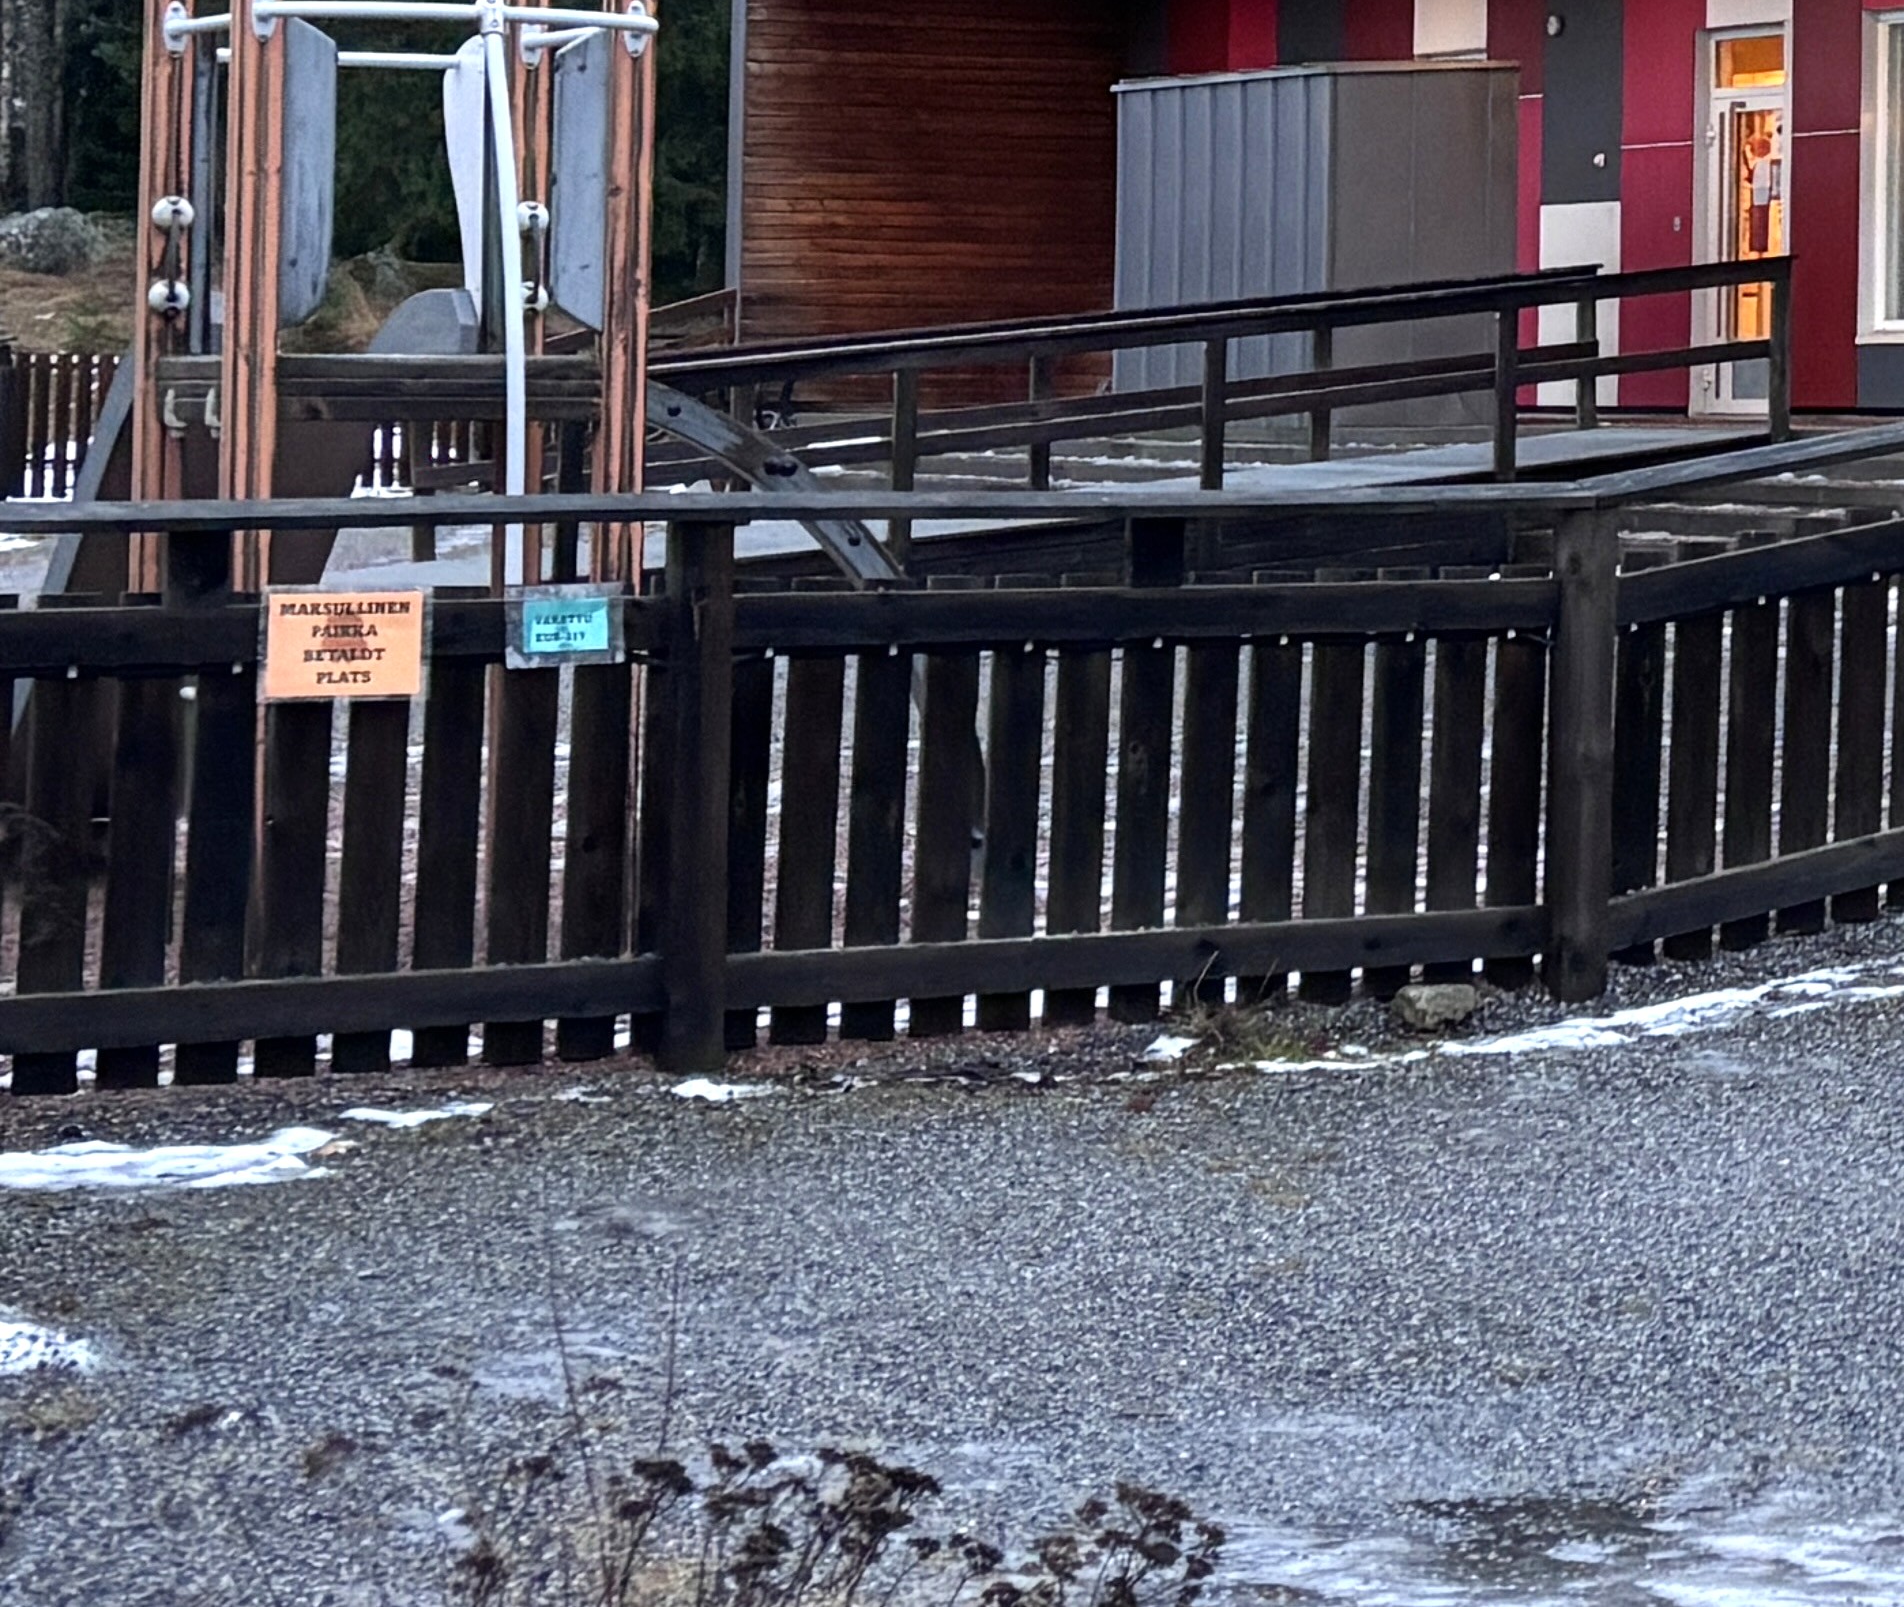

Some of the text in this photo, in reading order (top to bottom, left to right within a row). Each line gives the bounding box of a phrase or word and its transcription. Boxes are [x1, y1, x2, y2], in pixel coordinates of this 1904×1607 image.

[280, 602, 410, 616] MAKSULLINEN
[312, 624, 378, 637] PAIKKA
[316, 671, 371, 684] PLATS
